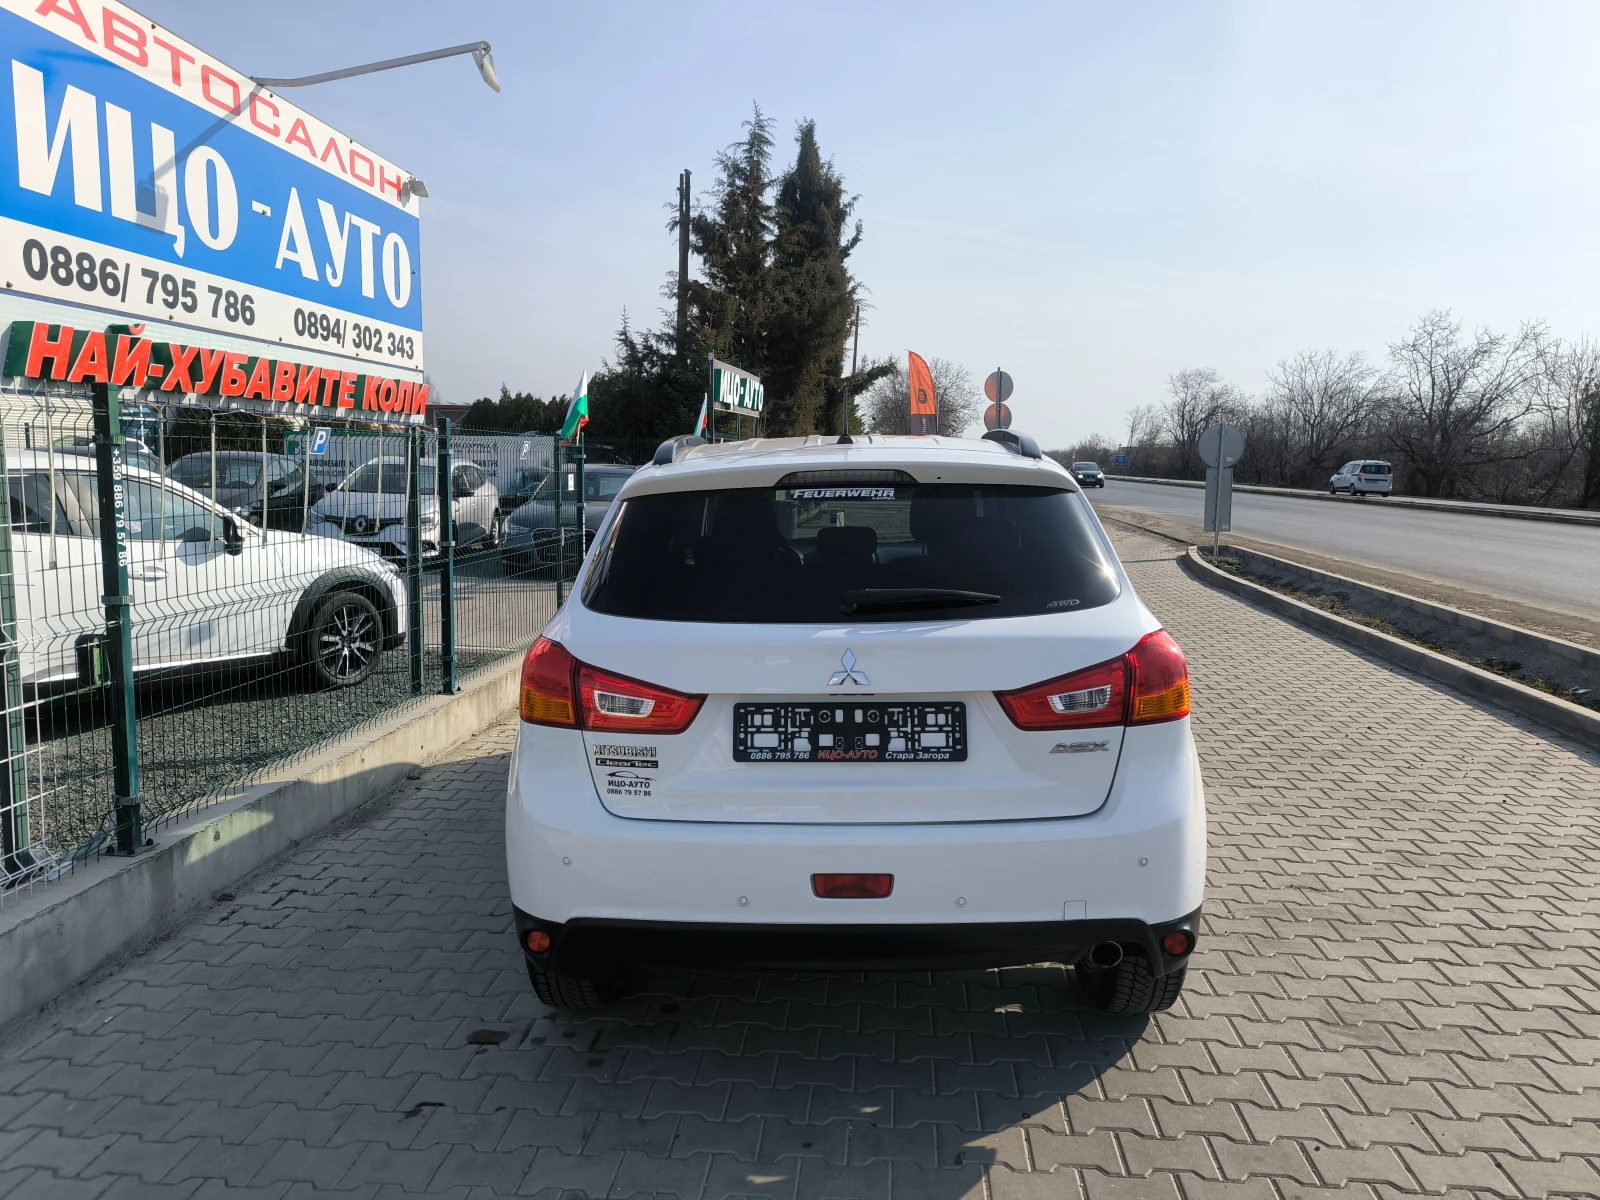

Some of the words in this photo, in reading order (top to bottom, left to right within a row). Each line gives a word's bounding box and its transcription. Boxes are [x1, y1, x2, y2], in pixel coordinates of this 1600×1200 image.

[35, 0, 402, 202] АВТОСАЛОН
[23, 239, 131, 303] 0886/
[141, 268, 197, 314] 795
[208, 285, 255, 326] 786
[294, 308, 347, 345] 0894/
[352, 323, 383, 354] 302
[388, 334, 415, 360] 343
[25, 322, 356, 409] НАЙ-ХУБАВИТЕ
[363, 375, 429, 415] КОЛИ
[719, 368, 764, 412] ИЦО-АУТО
[112, 448, 122, 480] +359
[113, 484, 124, 509] 886
[793, 489, 895, 499] FEUERWEHR
[115, 512, 125, 528] 79
[116, 532, 126, 547] 57
[118, 551, 128, 567] 86
[1046, 599, 1081, 609] AWD
[593, 744, 657, 758] MITSUBISHI
[818, 750, 879, 760] ИЦО-АУТО
[1049, 741, 1110, 754] ASX
[597, 759, 657, 767] ClearTec
[750, 752, 772, 760] 0886
[774, 752, 791, 760] 795
[793, 752, 810, 760] 786
[885, 751, 914, 760] Стара
[916, 751, 950, 760] Загора
[608, 780, 650, 788] ИЦО-АУТО
